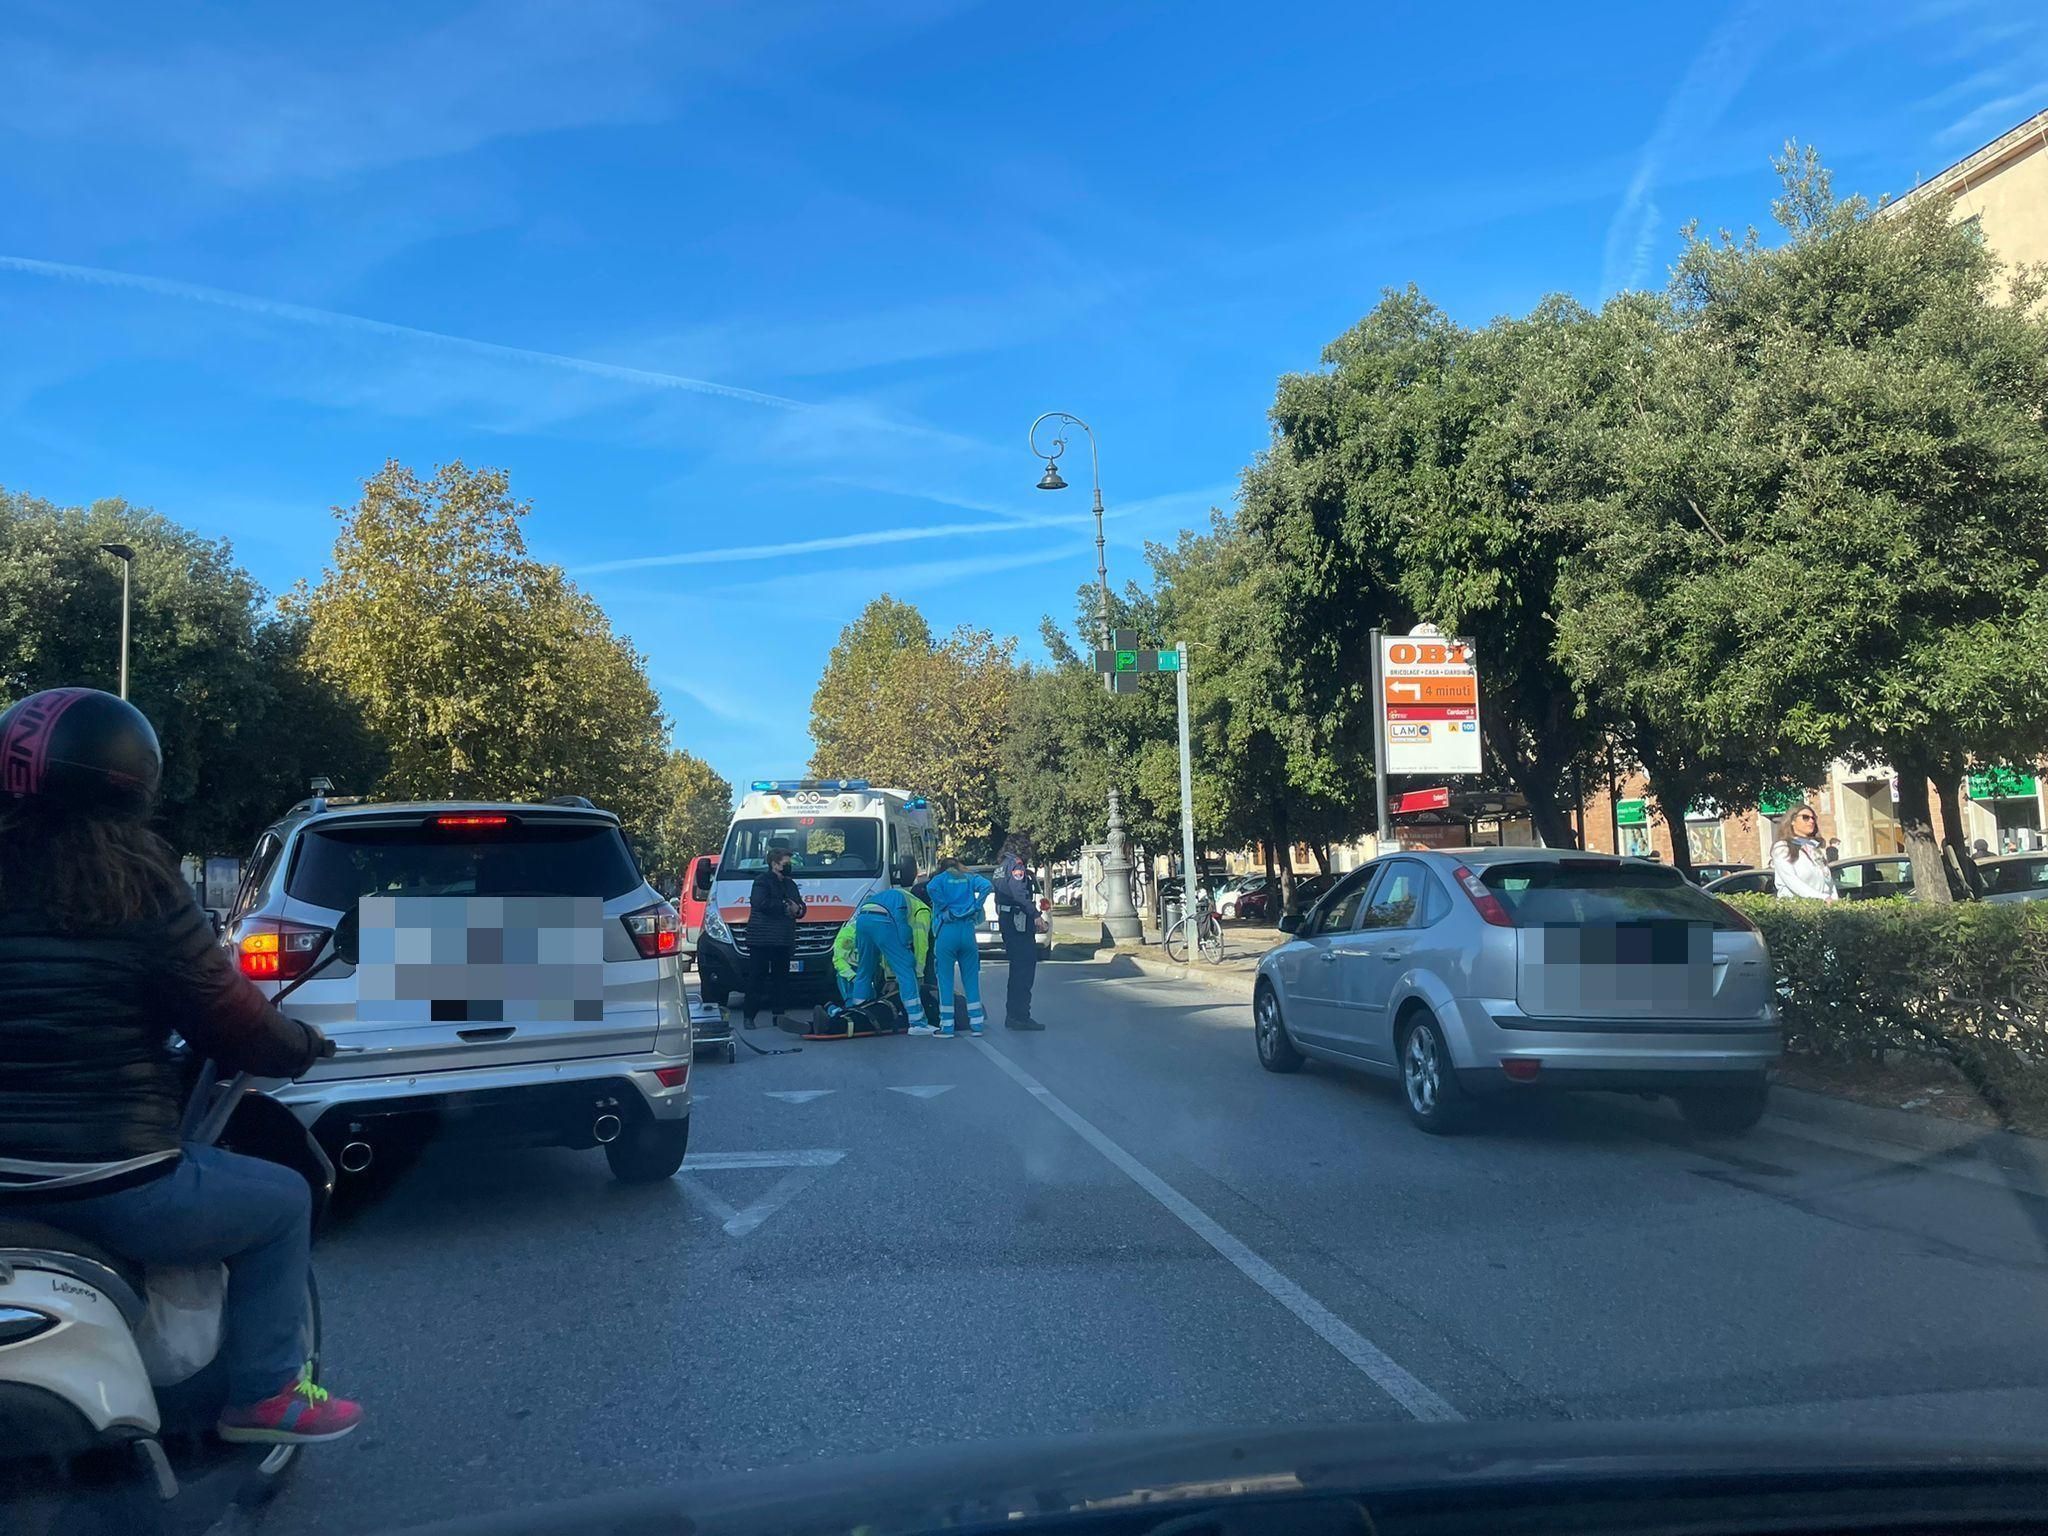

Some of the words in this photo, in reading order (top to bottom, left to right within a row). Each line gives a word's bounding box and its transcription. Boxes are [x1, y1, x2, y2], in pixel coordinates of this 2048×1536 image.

[1389, 644, 1468, 664] OBI
[1425, 686, 1432, 696] 4
[1436, 685, 1470, 696] minuti
[1392, 727, 1416, 736] LAM
